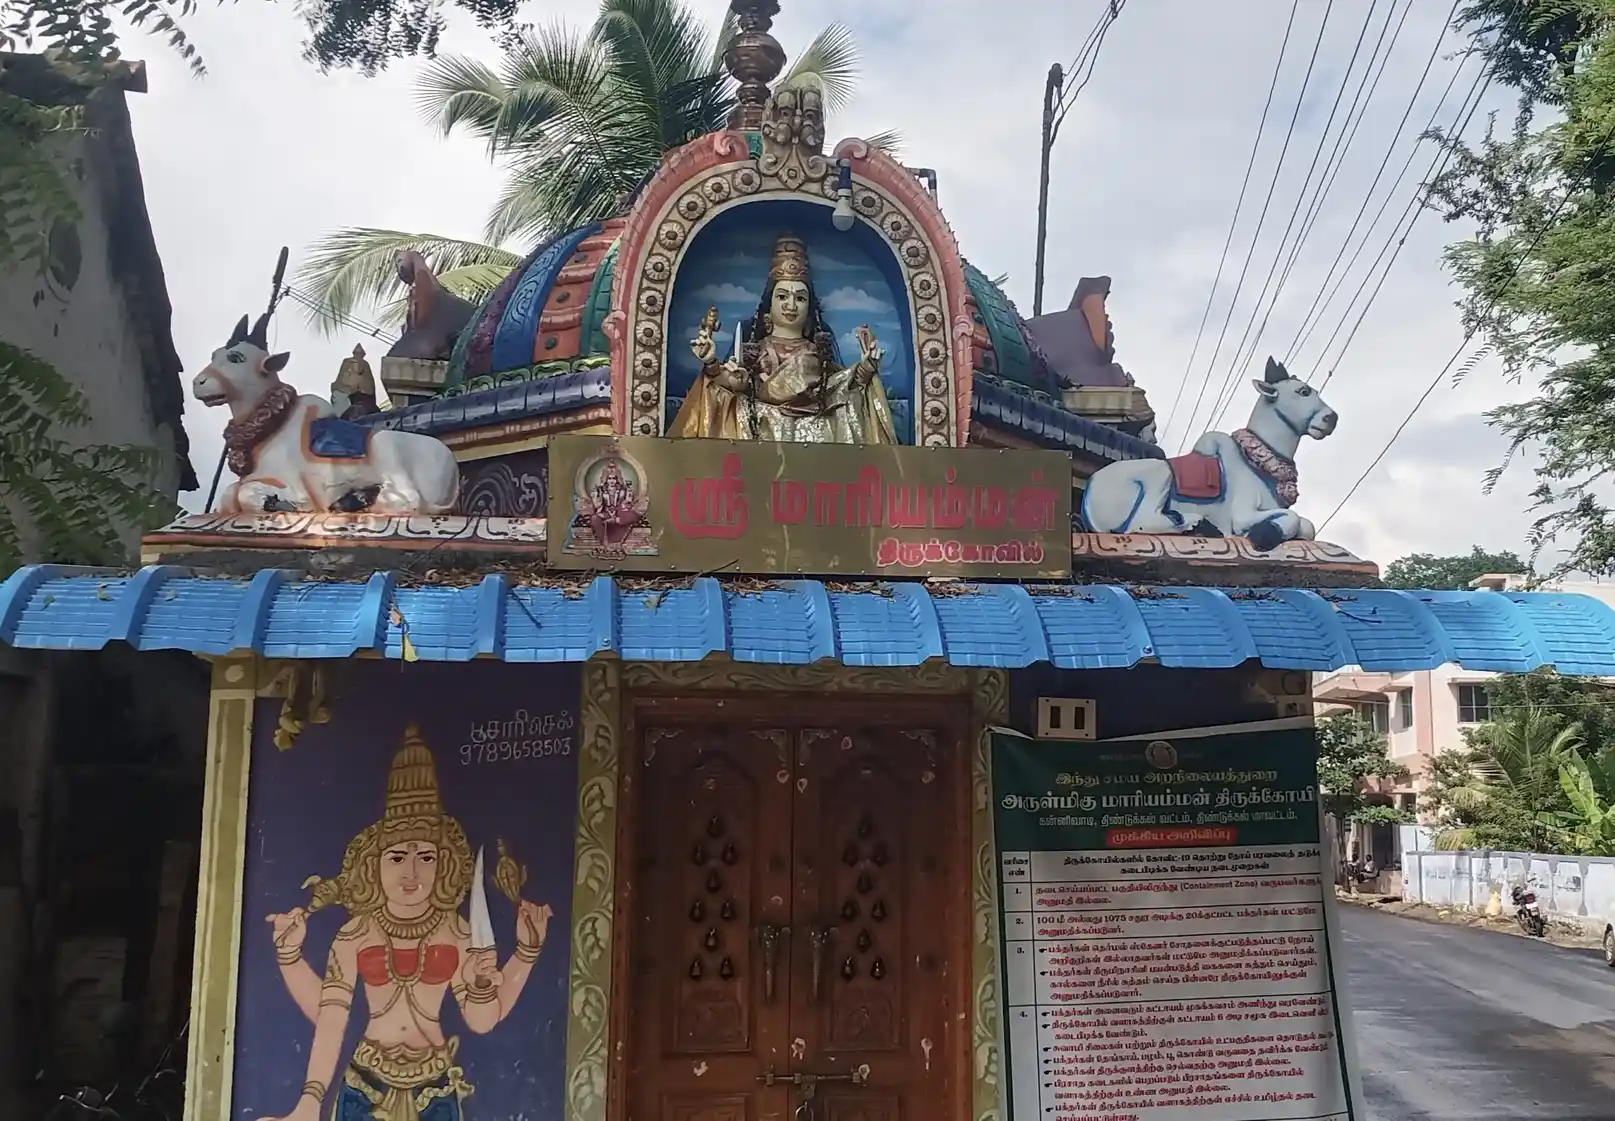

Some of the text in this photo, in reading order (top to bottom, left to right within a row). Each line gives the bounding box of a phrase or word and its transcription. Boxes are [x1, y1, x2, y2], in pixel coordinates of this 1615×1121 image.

[670, 453, 1059, 539] ஸ்ரீ மாரியம்மன்
[877, 539, 1044, 567] திருக்கோவில்
[460, 737, 572, 765] 9789658503
[1056, 772, 1099, 787] இந்து
[1143, 768, 1277, 784] அறநிலையத்துறை
[1001, 785, 1314, 812] அருள்மிகு மாரியம்மன் திருக்கோயி
[1101, 813, 1156, 827] திண்டுக்கல்
[1196, 810, 1249, 824] திண்டுக்கல்
[1167, 828, 1231, 841] அறிவிப்பு
[1181, 880, 1233, 891] (Containment
[1037, 916, 1055, 924] 100
[1104, 914, 1126, 923] 1075
